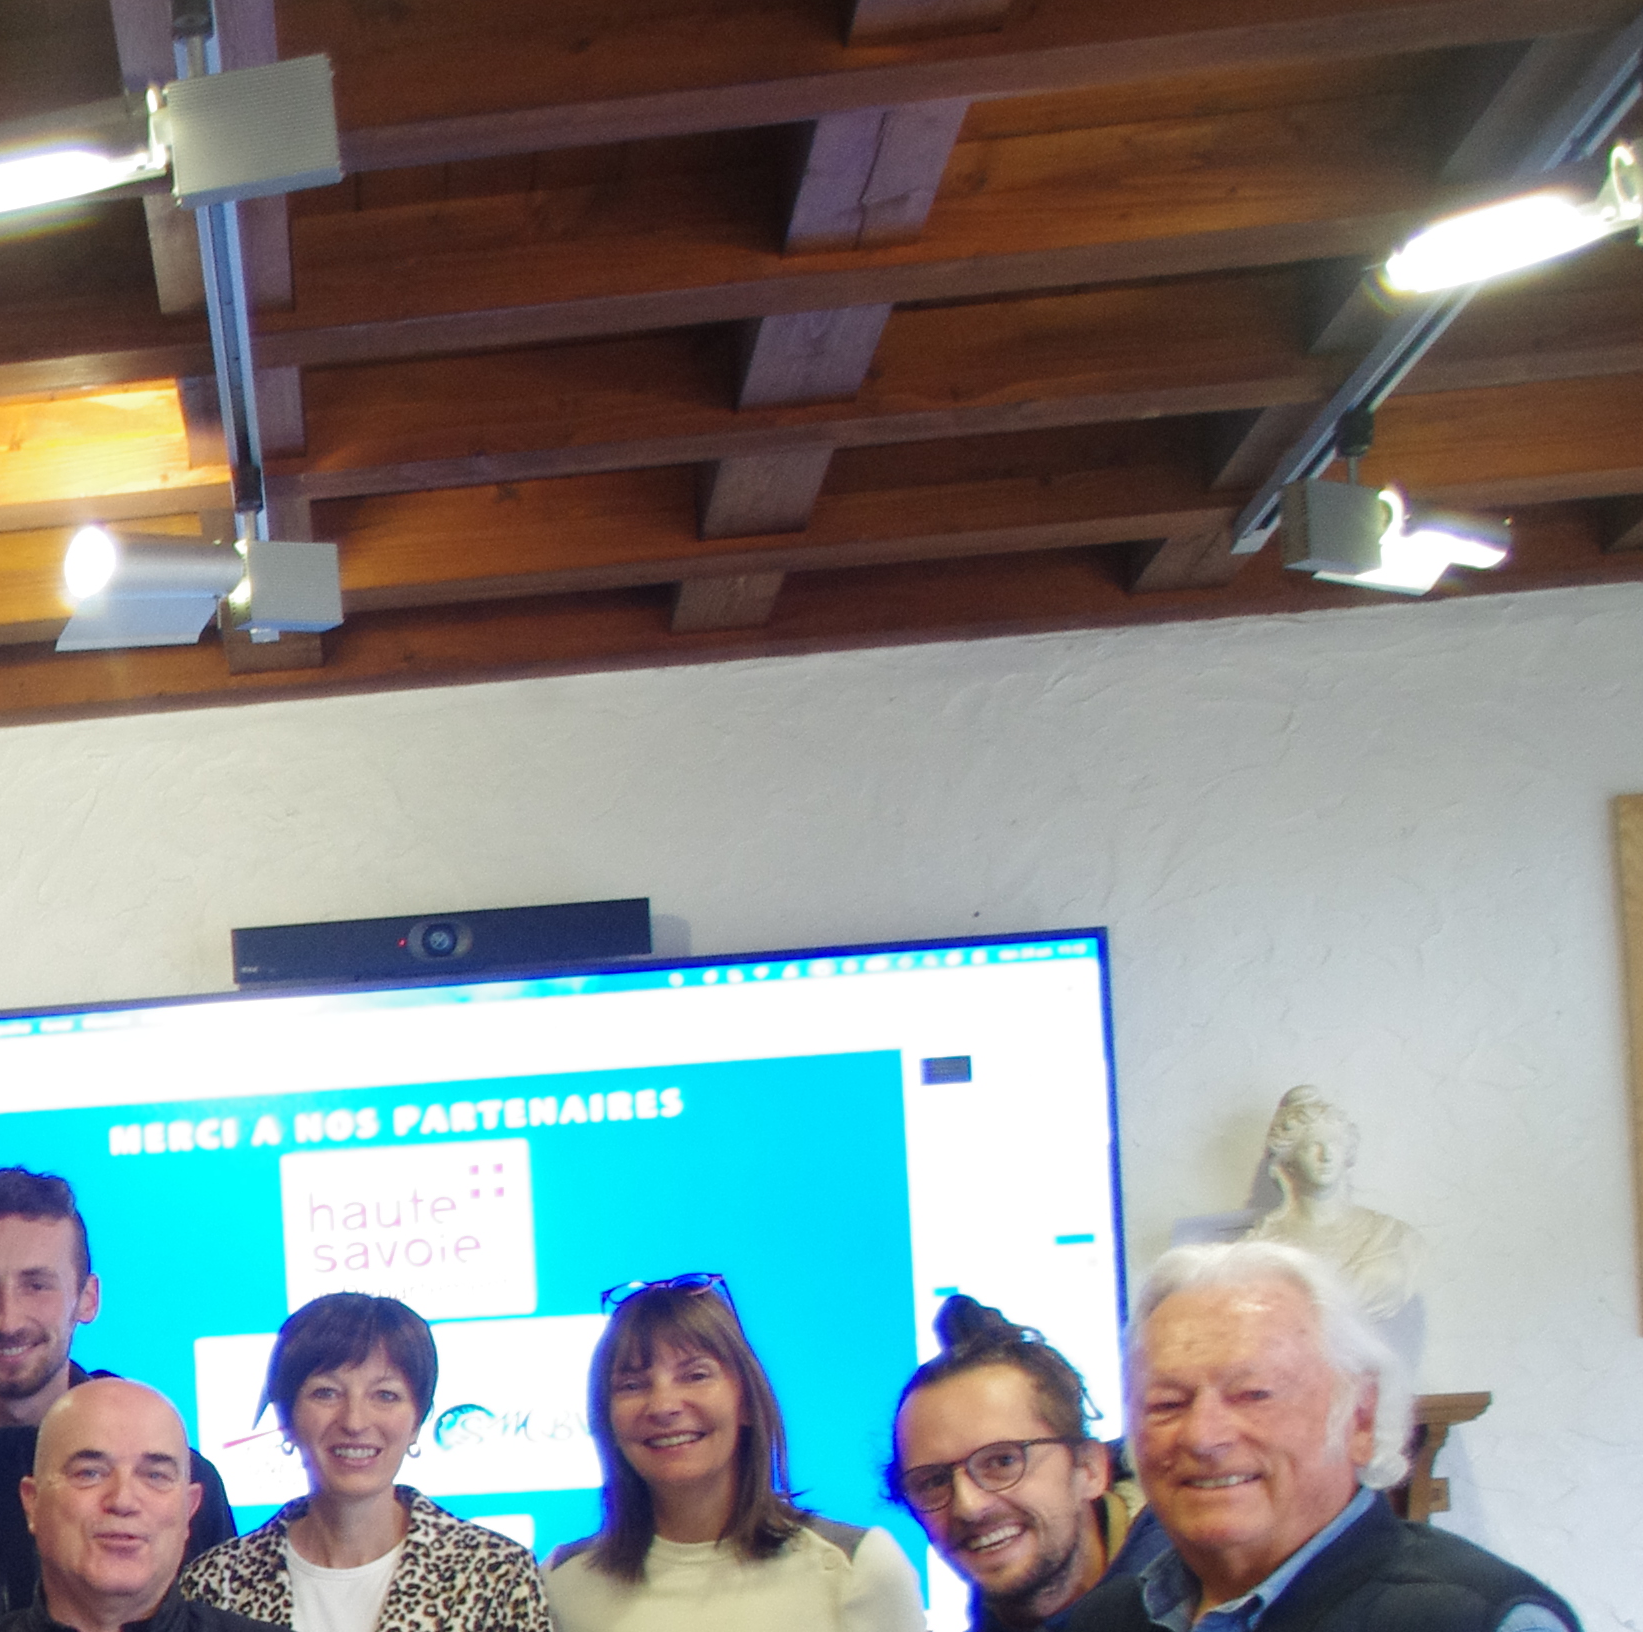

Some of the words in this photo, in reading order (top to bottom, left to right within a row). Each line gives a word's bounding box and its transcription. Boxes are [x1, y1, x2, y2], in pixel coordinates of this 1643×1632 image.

[109, 1115, 239, 1156] MERCI
[251, 1114, 281, 1147] A
[294, 1106, 379, 1144] NOS
[393, 1087, 684, 1137] PARTENAIRES
[309, 1188, 457, 1233] haute
[313, 1234, 481, 1274] savoie
